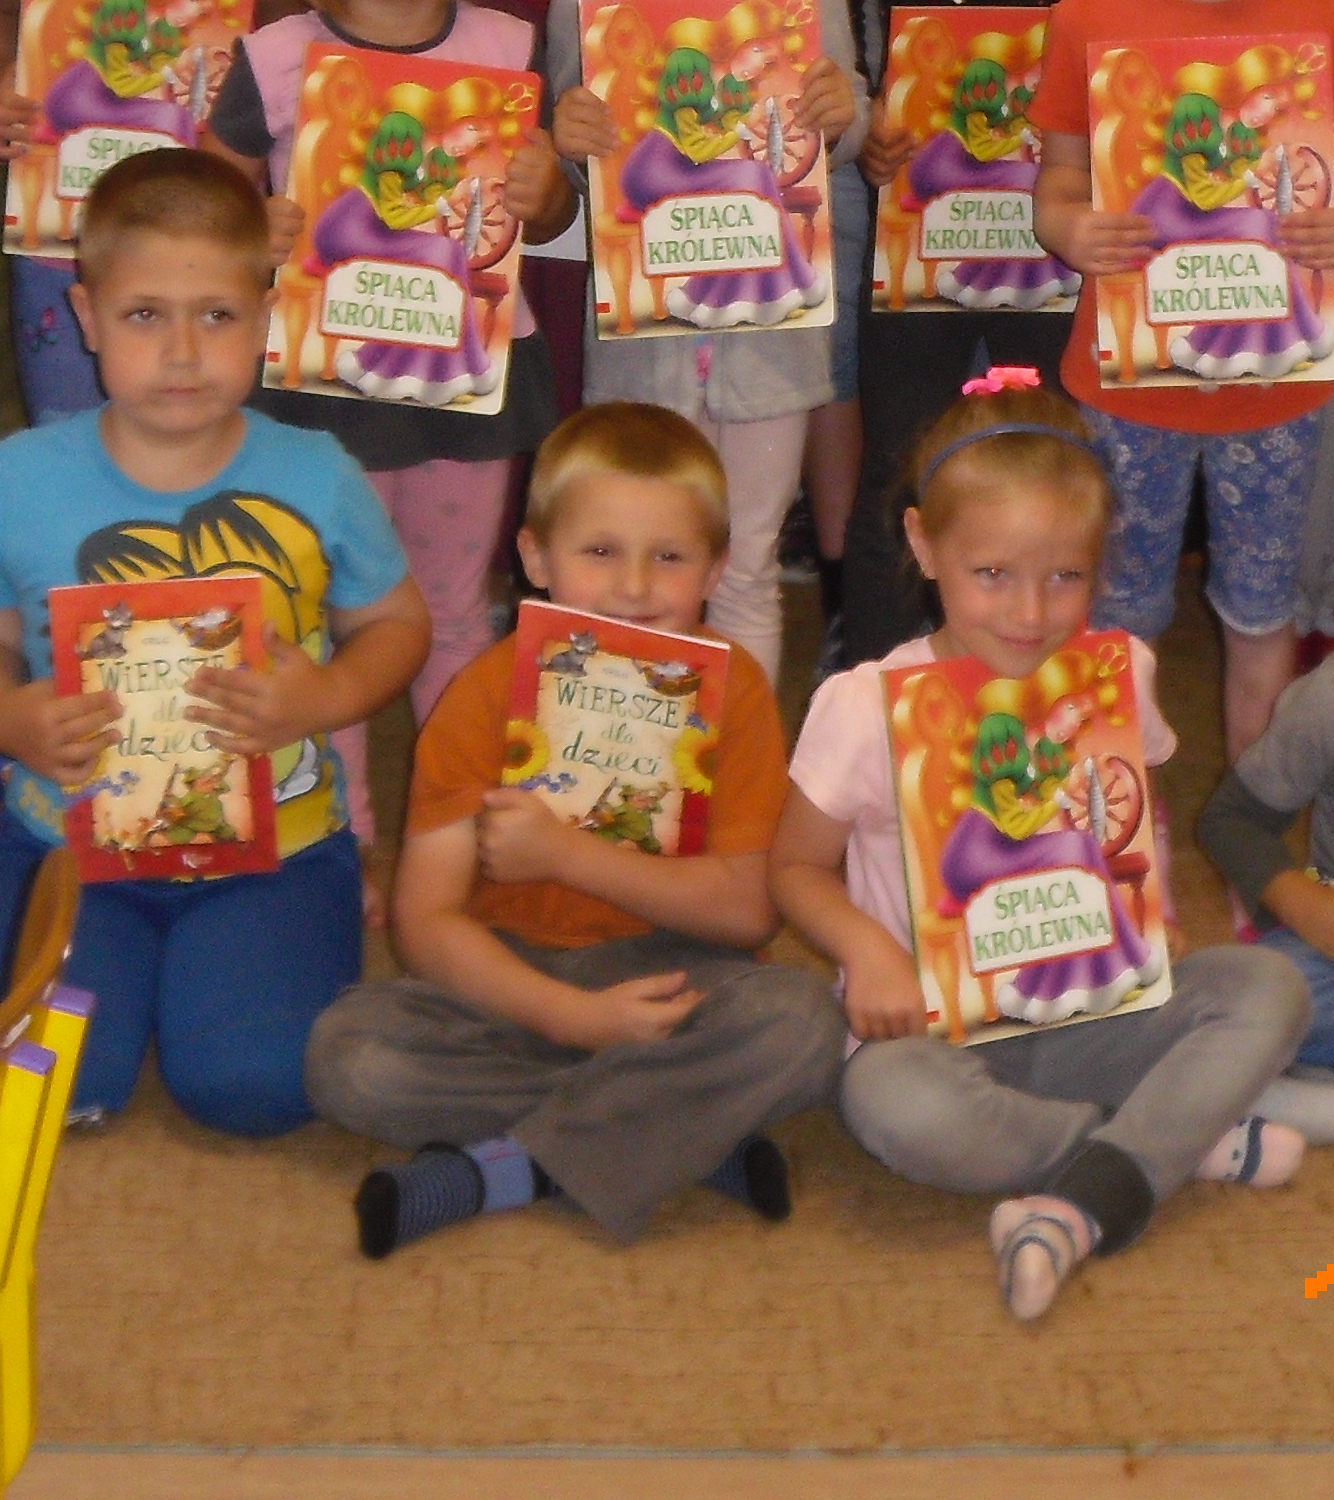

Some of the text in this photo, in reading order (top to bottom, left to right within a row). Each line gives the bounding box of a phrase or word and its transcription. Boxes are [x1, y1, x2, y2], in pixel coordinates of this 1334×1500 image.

[669, 200, 755, 233] ŚPIĄCA
[949, 194, 1026, 225] ŚPIĄCA
[647, 232, 780, 265] KRÓLEWNA
[924, 224, 1036, 251] KRÓLEWN
[1175, 248, 1261, 282] ŚPIĄCA
[354, 263, 438, 303] ŚPIĄCA
[1151, 280, 1287, 314] KRÓLEWNA
[325, 297, 460, 338] KRÓLEWNA
[117, 718, 215, 762] dziec
[600, 722, 636, 745] dla
[561, 730, 662, 776] dzieci
[993, 880, 1081, 922] ŚPIĄCA
[974, 910, 1110, 962] KRÓLEWNA
